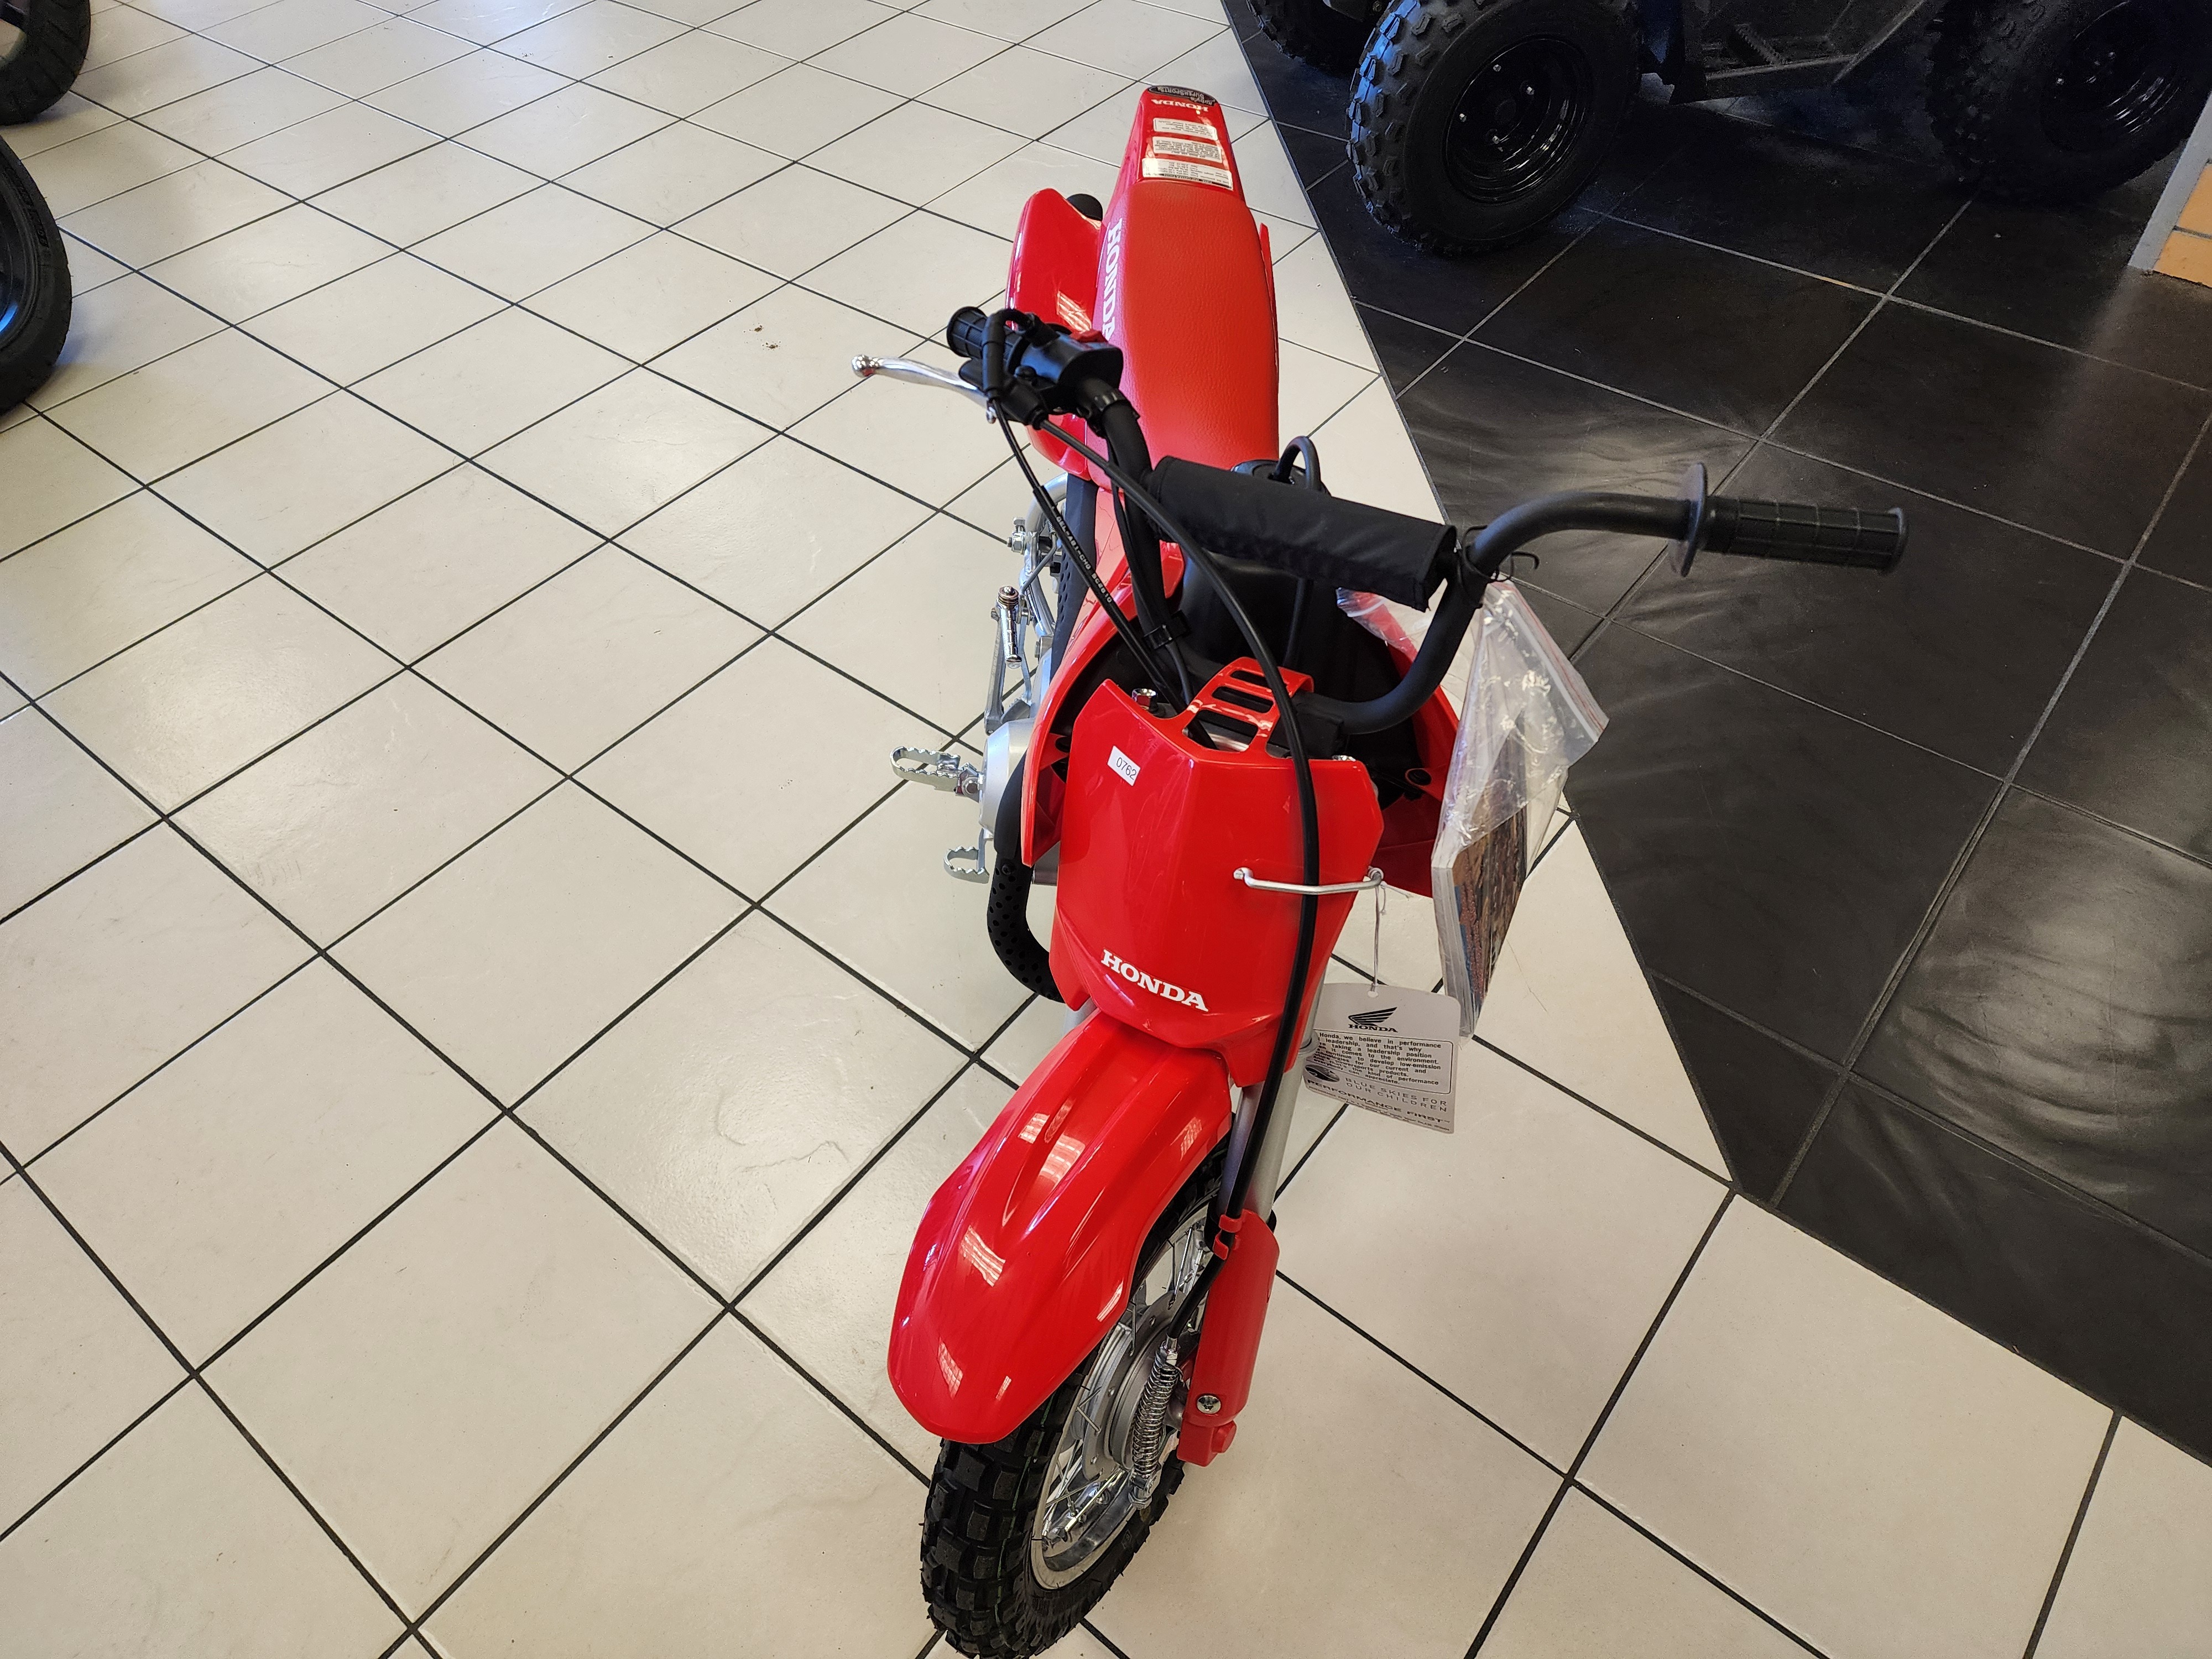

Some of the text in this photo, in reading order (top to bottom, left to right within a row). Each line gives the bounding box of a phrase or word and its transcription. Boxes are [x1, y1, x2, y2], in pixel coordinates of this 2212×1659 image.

[1151, 99, 1209, 112] HONDA
[1102, 217, 1123, 342] HONDA
[1116, 757, 1137, 780] 0762
[1100, 949, 1209, 1012] HONDA
[1348, 1024, 1399, 1033] HONDA
[1326, 1051, 1352, 1059] continue
[1367, 1048, 1400, 1056] leadership
[1345, 1078, 1447, 1106] BLUE SKIES FOR
[1398, 1077, 1439, 1085] performance
[1307, 1079, 1402, 1112] PERFORMANCE
[1346, 1082, 1371, 1093] OUR
[1377, 1092, 1447, 1112] CHILDREN
